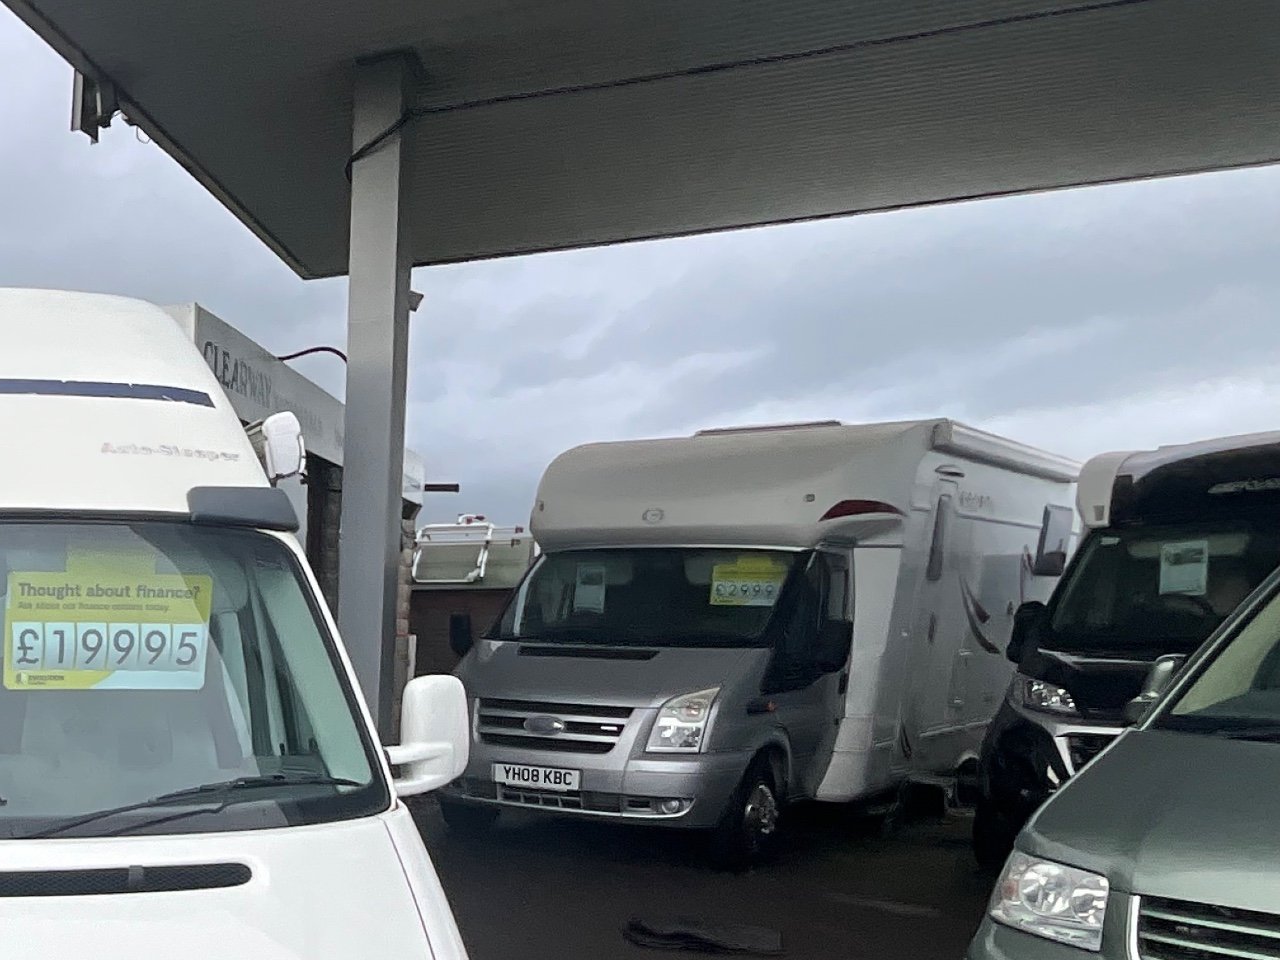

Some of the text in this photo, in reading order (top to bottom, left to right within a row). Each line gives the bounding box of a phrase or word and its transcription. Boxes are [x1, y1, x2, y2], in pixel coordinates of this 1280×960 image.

[18, 582, 200, 600] Thought about finance?
[16, 628, 199, 666] £19995
[503, 766, 573, 786] YH08 KBC
